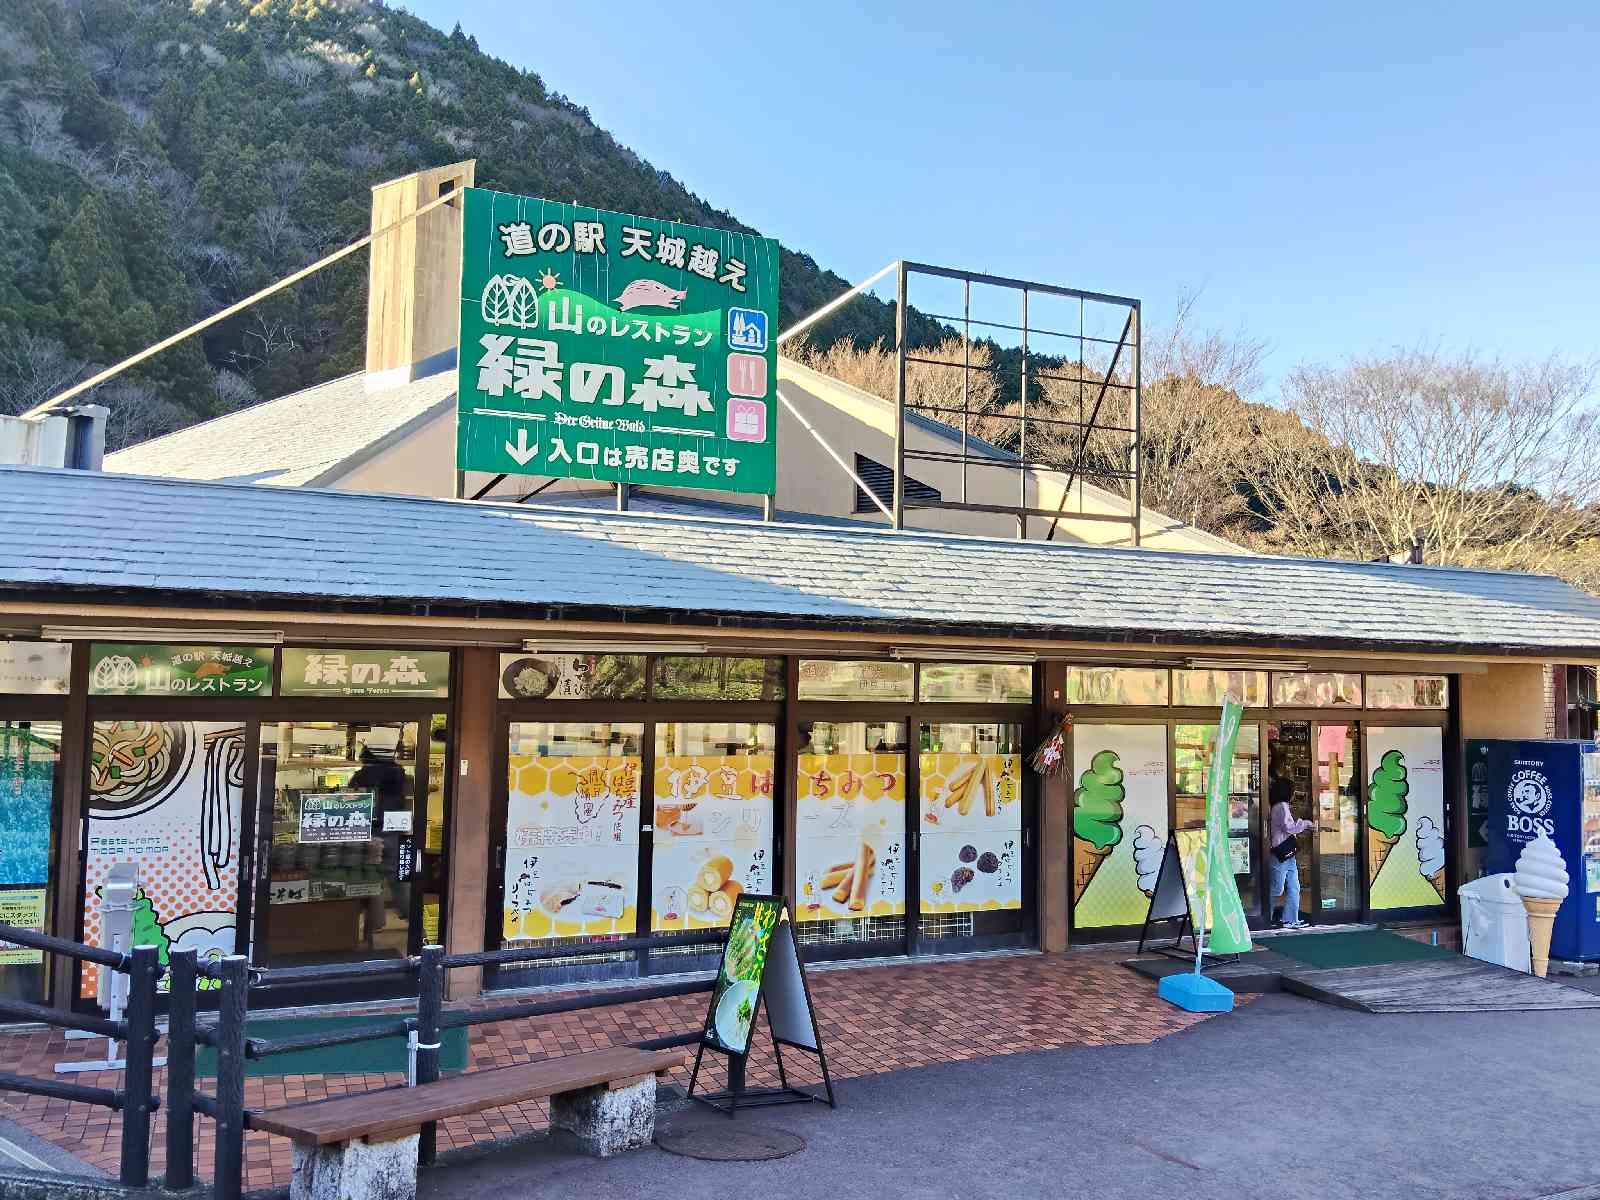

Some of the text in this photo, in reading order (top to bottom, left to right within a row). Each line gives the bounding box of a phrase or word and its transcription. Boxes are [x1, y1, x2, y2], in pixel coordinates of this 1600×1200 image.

[499, 221, 748, 293] 道の駅 天城越え
[547, 296, 714, 348] 山のレストラン
[476, 333, 715, 417] 緑の森
[547, 437, 741, 477] 入口は売店奥です
[144, 667, 262, 692] 山のレストラン
[303, 654, 428, 685] 緑の森
[1511, 769, 1548, 786] COFFEE
[302, 811, 371, 828] 緑の森
[1506, 814, 1555, 836] BOSS
